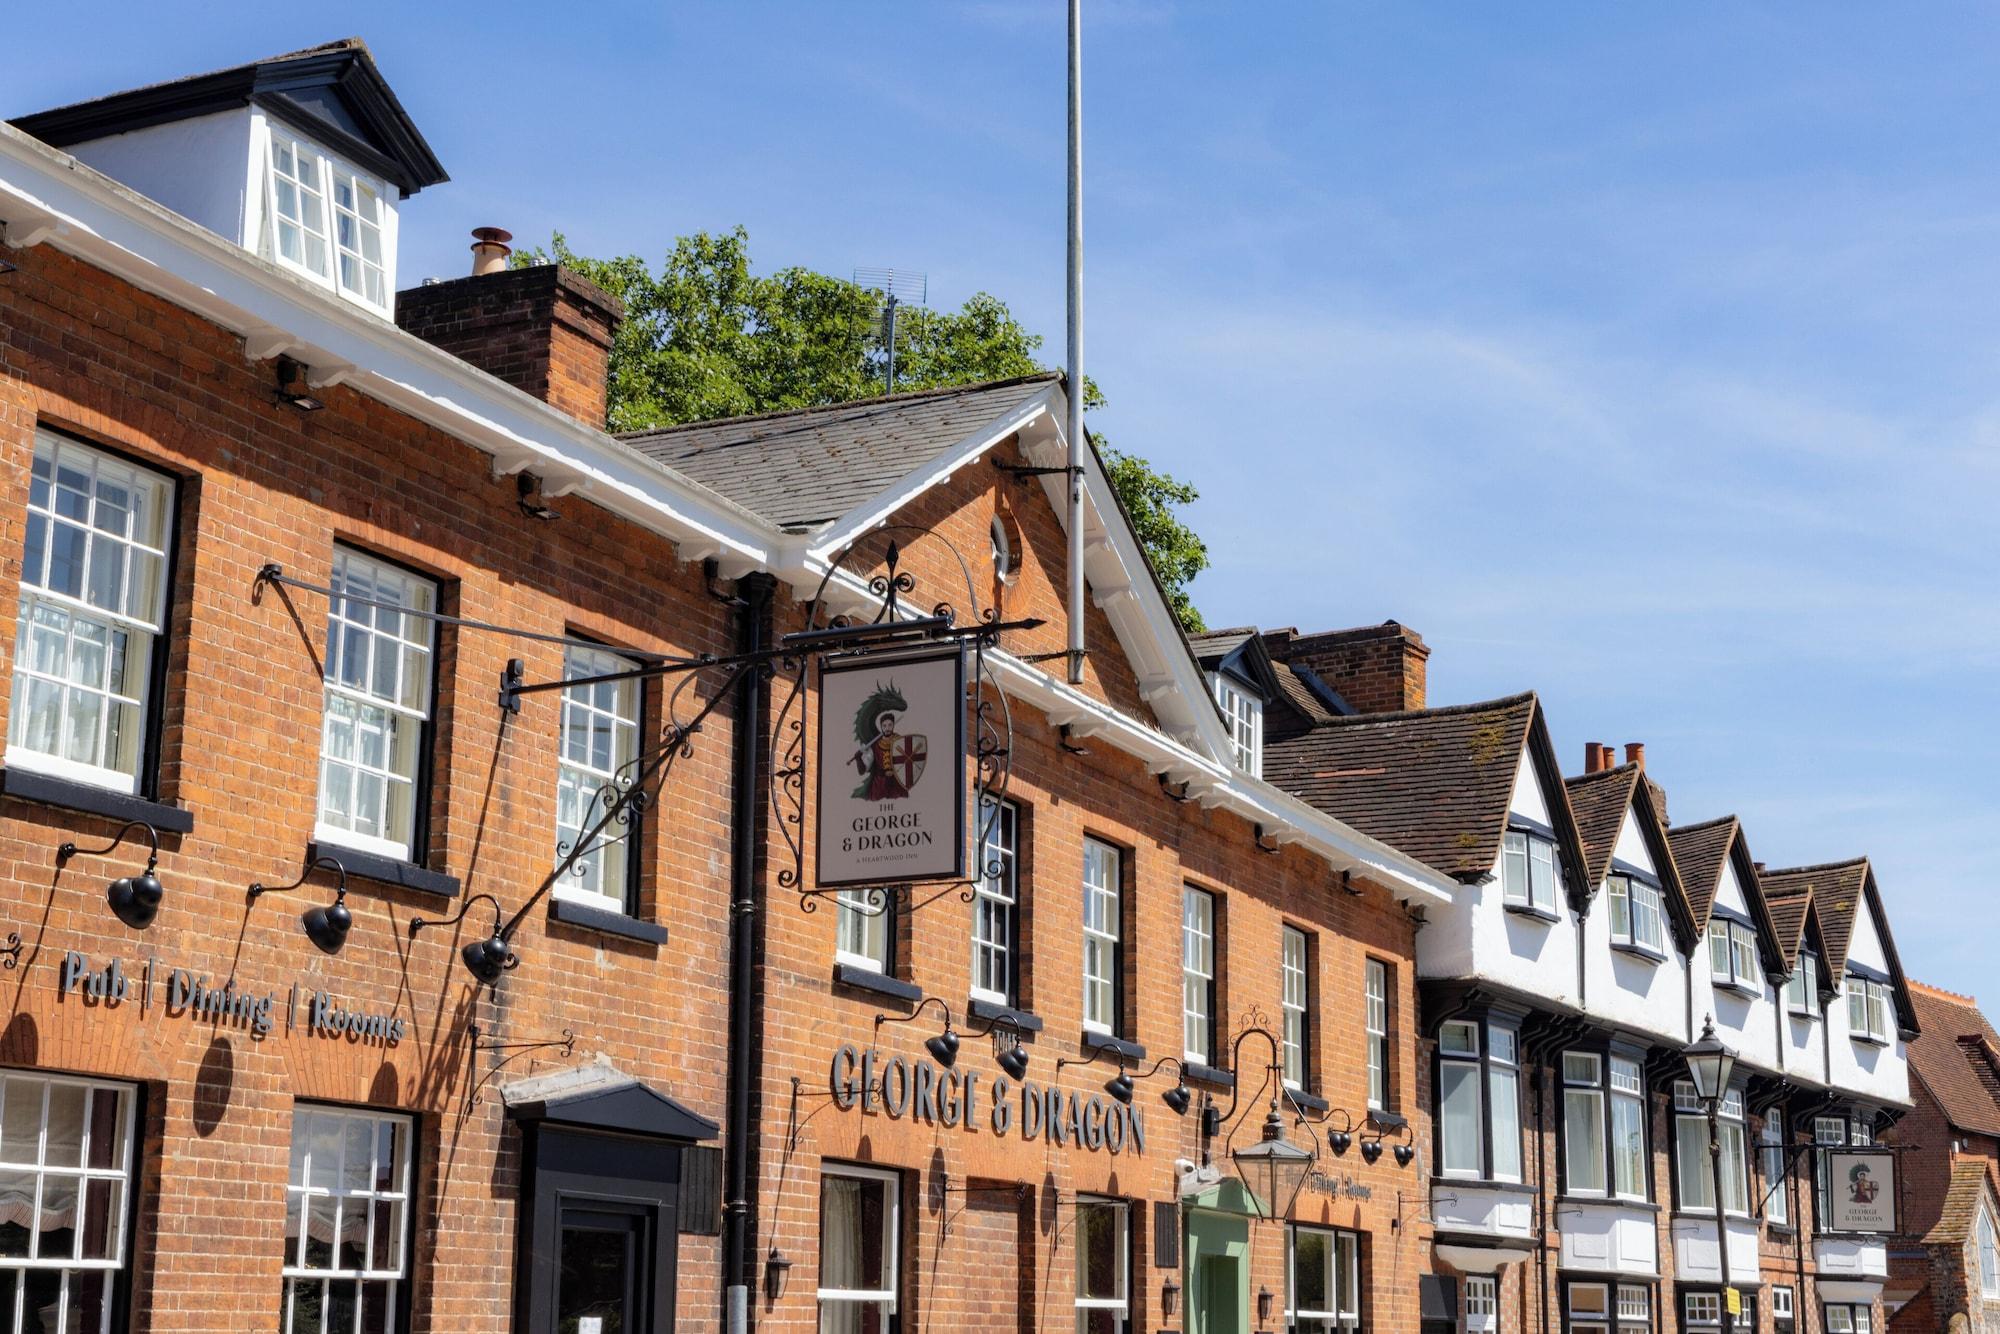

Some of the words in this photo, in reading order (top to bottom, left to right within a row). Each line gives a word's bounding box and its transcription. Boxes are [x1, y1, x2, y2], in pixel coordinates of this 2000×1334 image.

[880, 803, 894, 812] THE
[852, 812, 922, 832] GEORGE
[842, 838, 852, 852] &
[858, 831, 932, 851] DRAGON
[65, 951, 129, 999] Pub
[171, 968, 276, 1033] Dining
[314, 990, 407, 1042] Rooms
[833, 1043, 983, 1129] GEORGE
[993, 1076, 1013, 1134] &
[1024, 1080, 1145, 1154] DRAGON
